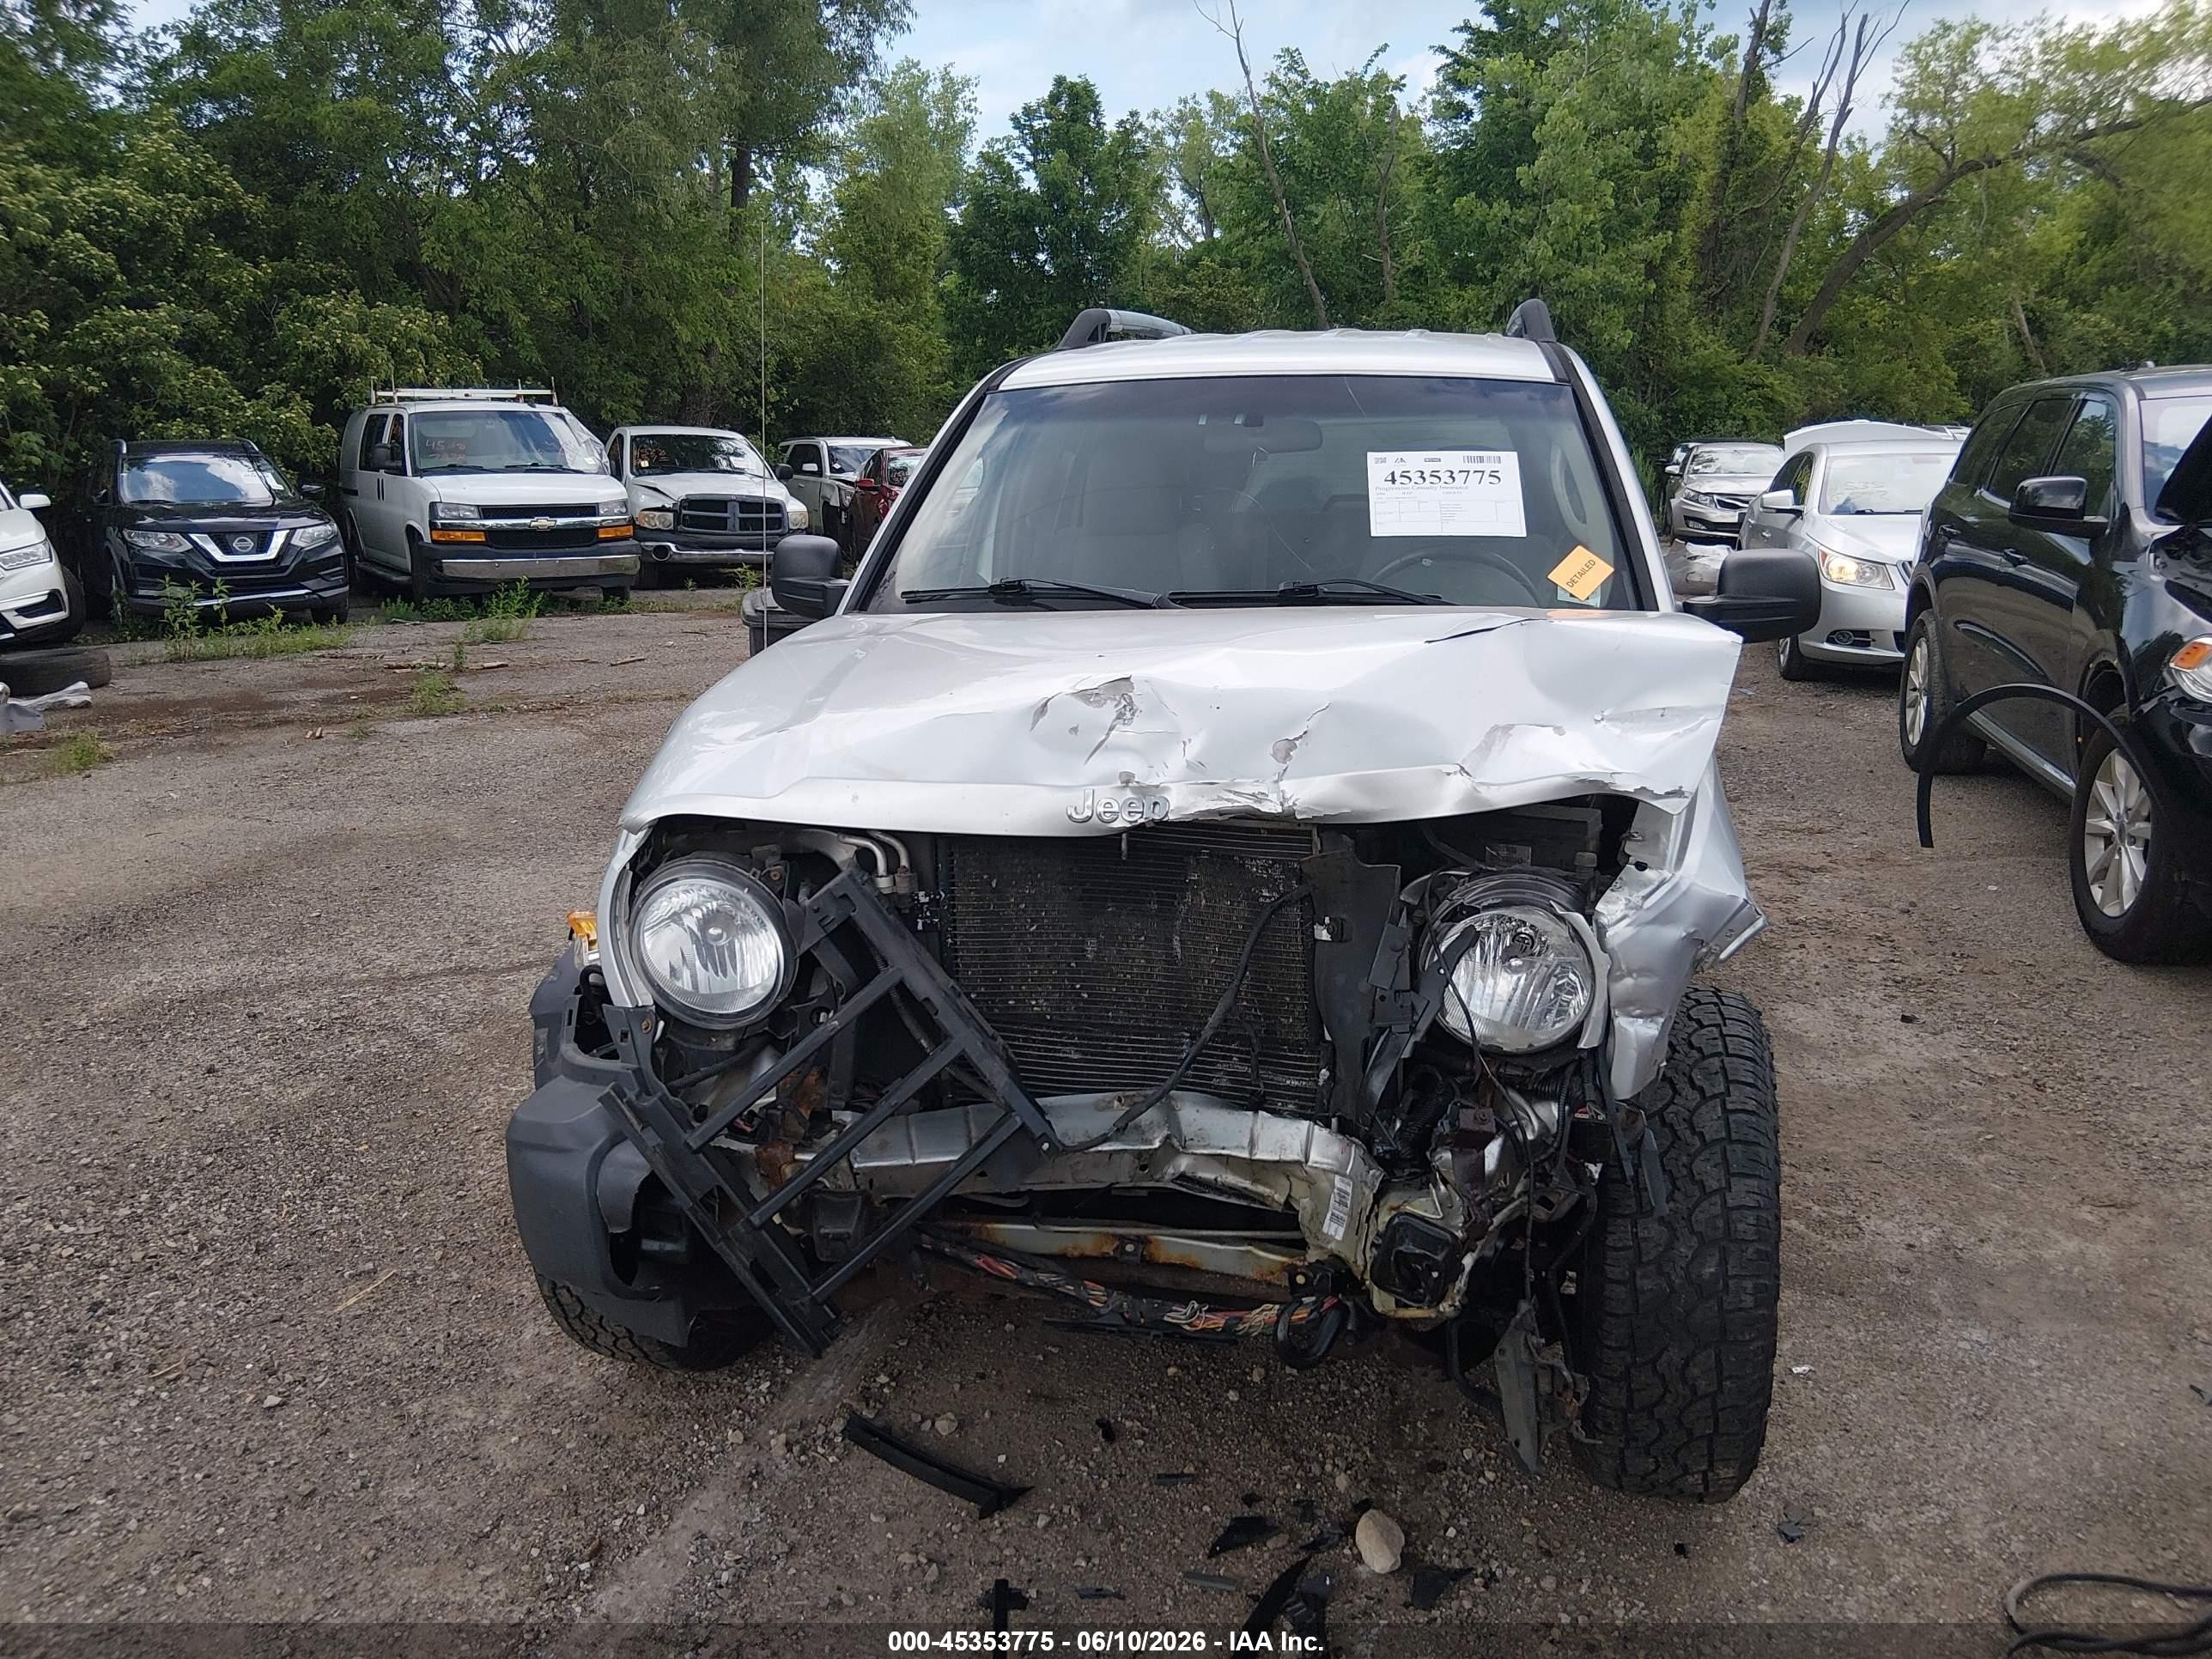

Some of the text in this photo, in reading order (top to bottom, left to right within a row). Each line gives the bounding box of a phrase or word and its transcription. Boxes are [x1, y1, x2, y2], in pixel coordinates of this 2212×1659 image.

[1384, 470, 1501, 485] 45353775
[1565, 559, 1596, 588] DETAILED
[1066, 788, 1170, 824] Jeep
